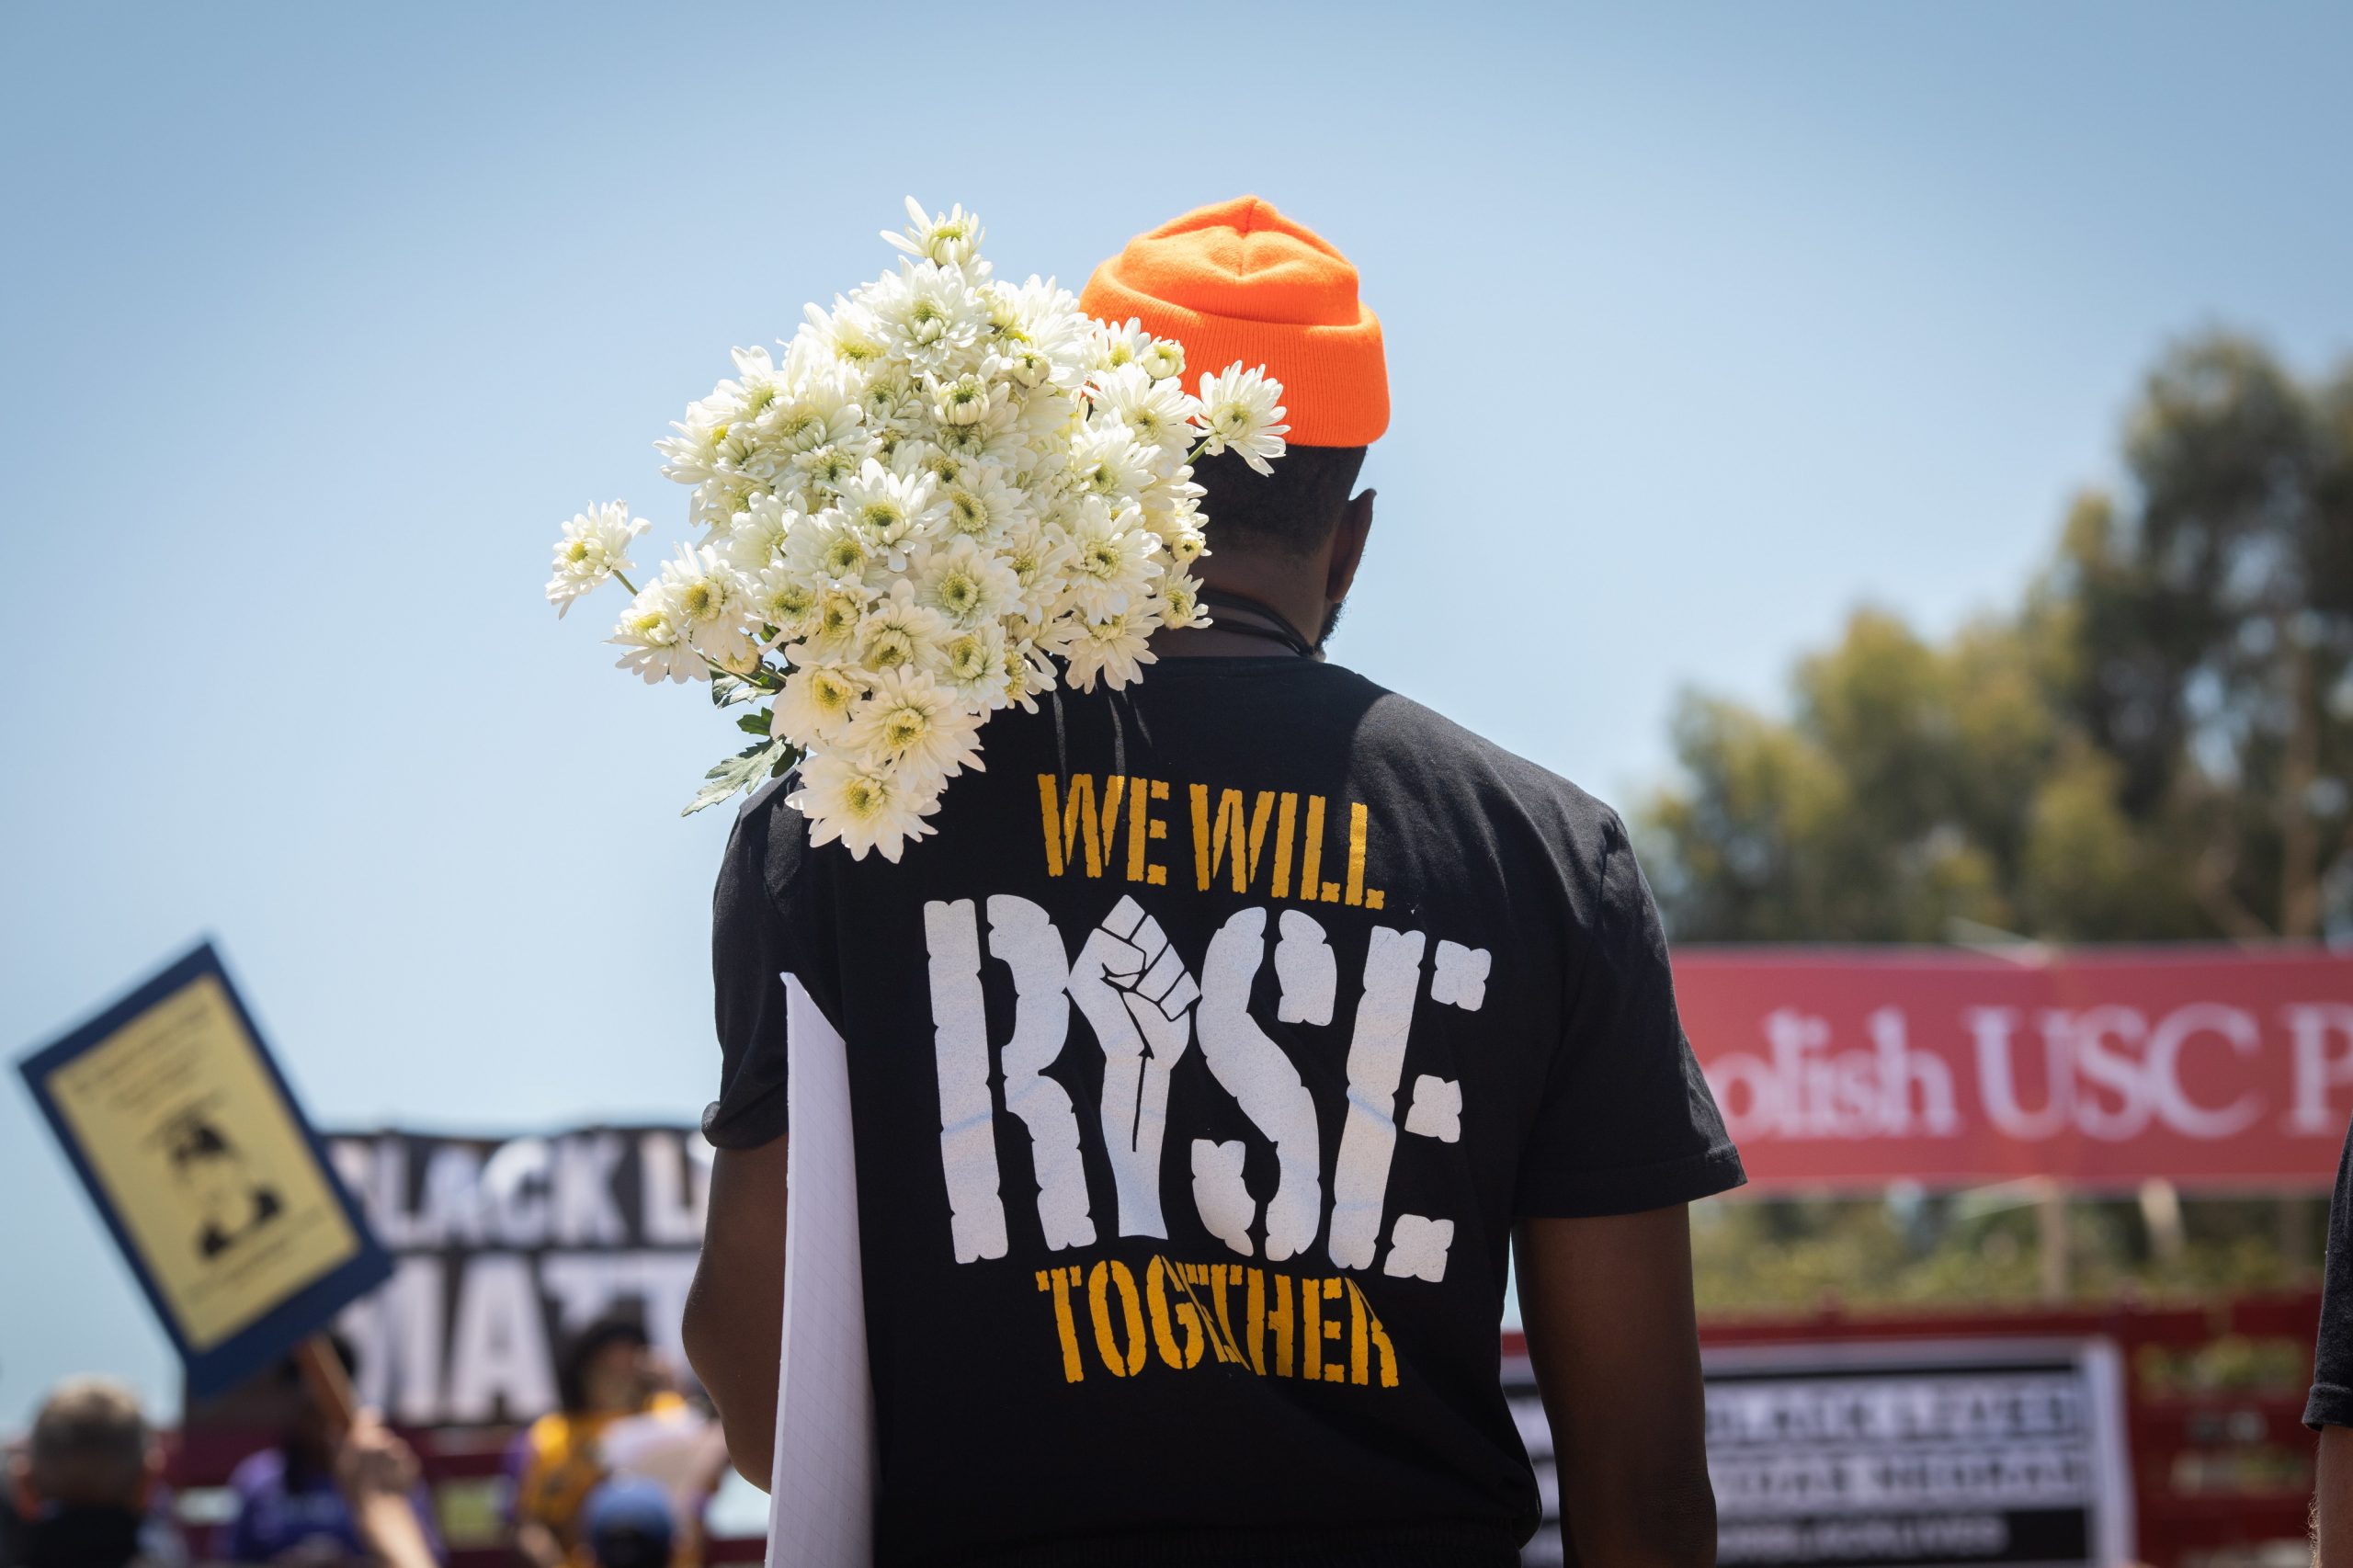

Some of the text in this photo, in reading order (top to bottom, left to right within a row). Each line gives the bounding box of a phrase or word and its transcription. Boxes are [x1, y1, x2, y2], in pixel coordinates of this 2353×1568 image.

[1037, 773, 1385, 909] WE WILL
[1964, 1004, 2264, 1140] USC
